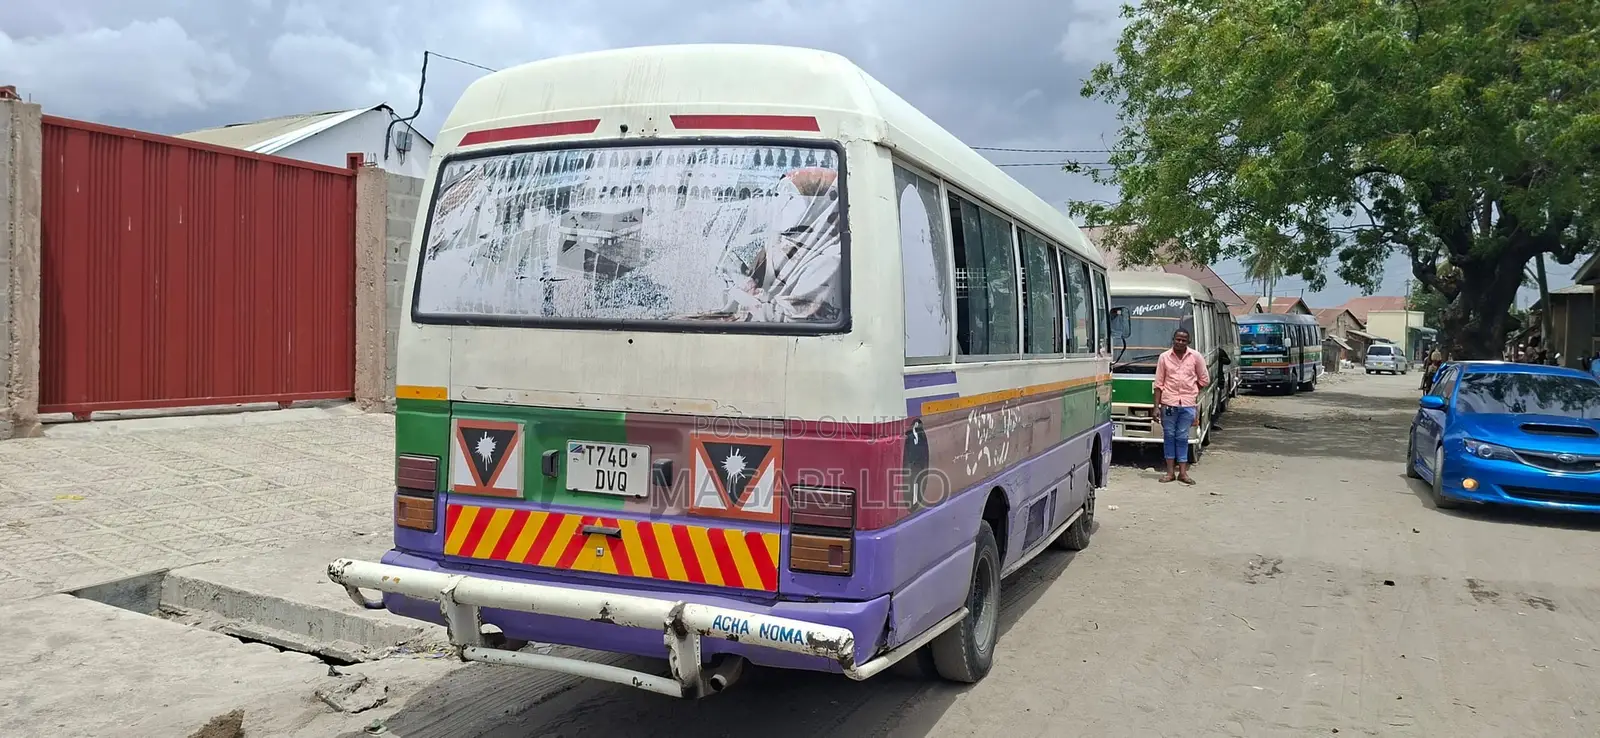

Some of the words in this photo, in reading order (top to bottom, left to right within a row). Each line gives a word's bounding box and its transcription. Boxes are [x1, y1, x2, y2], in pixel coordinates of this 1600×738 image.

[1132, 303, 1166, 316] African
[1167, 298, 1186, 309] Boy
[585, 444, 629, 468] T740
[595, 469, 628, 492] DVQ
[712, 614, 750, 635] ACHA
